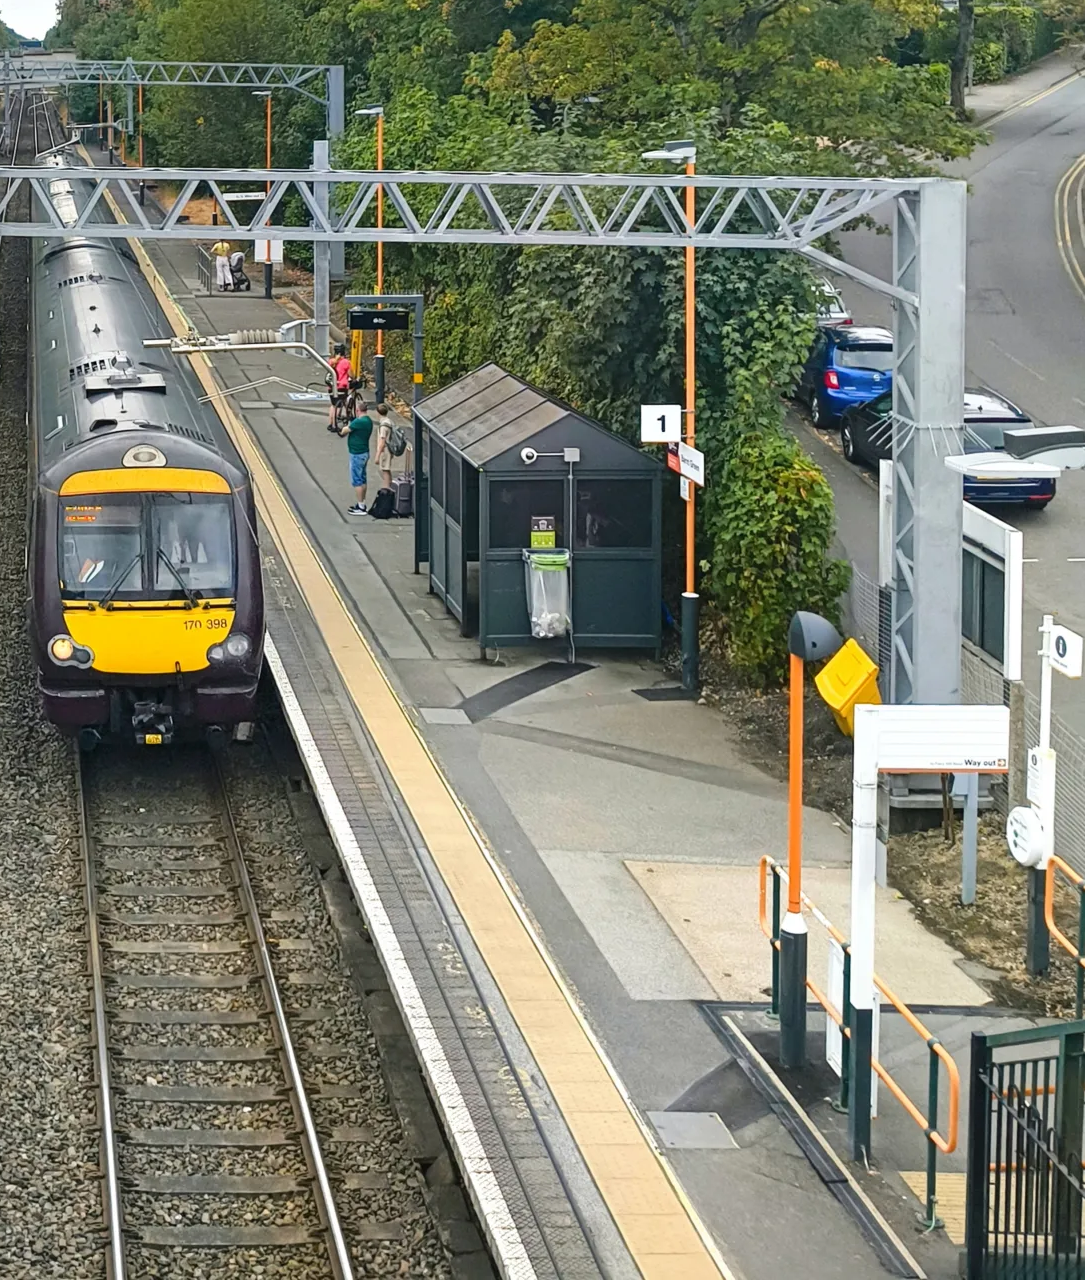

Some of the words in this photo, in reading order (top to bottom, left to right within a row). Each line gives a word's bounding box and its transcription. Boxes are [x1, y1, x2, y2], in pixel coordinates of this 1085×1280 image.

[657, 415, 666, 432] 1
[183, 620, 202, 630] 170
[206, 619, 227, 630] 398
[964, 759, 981, 767] Way
